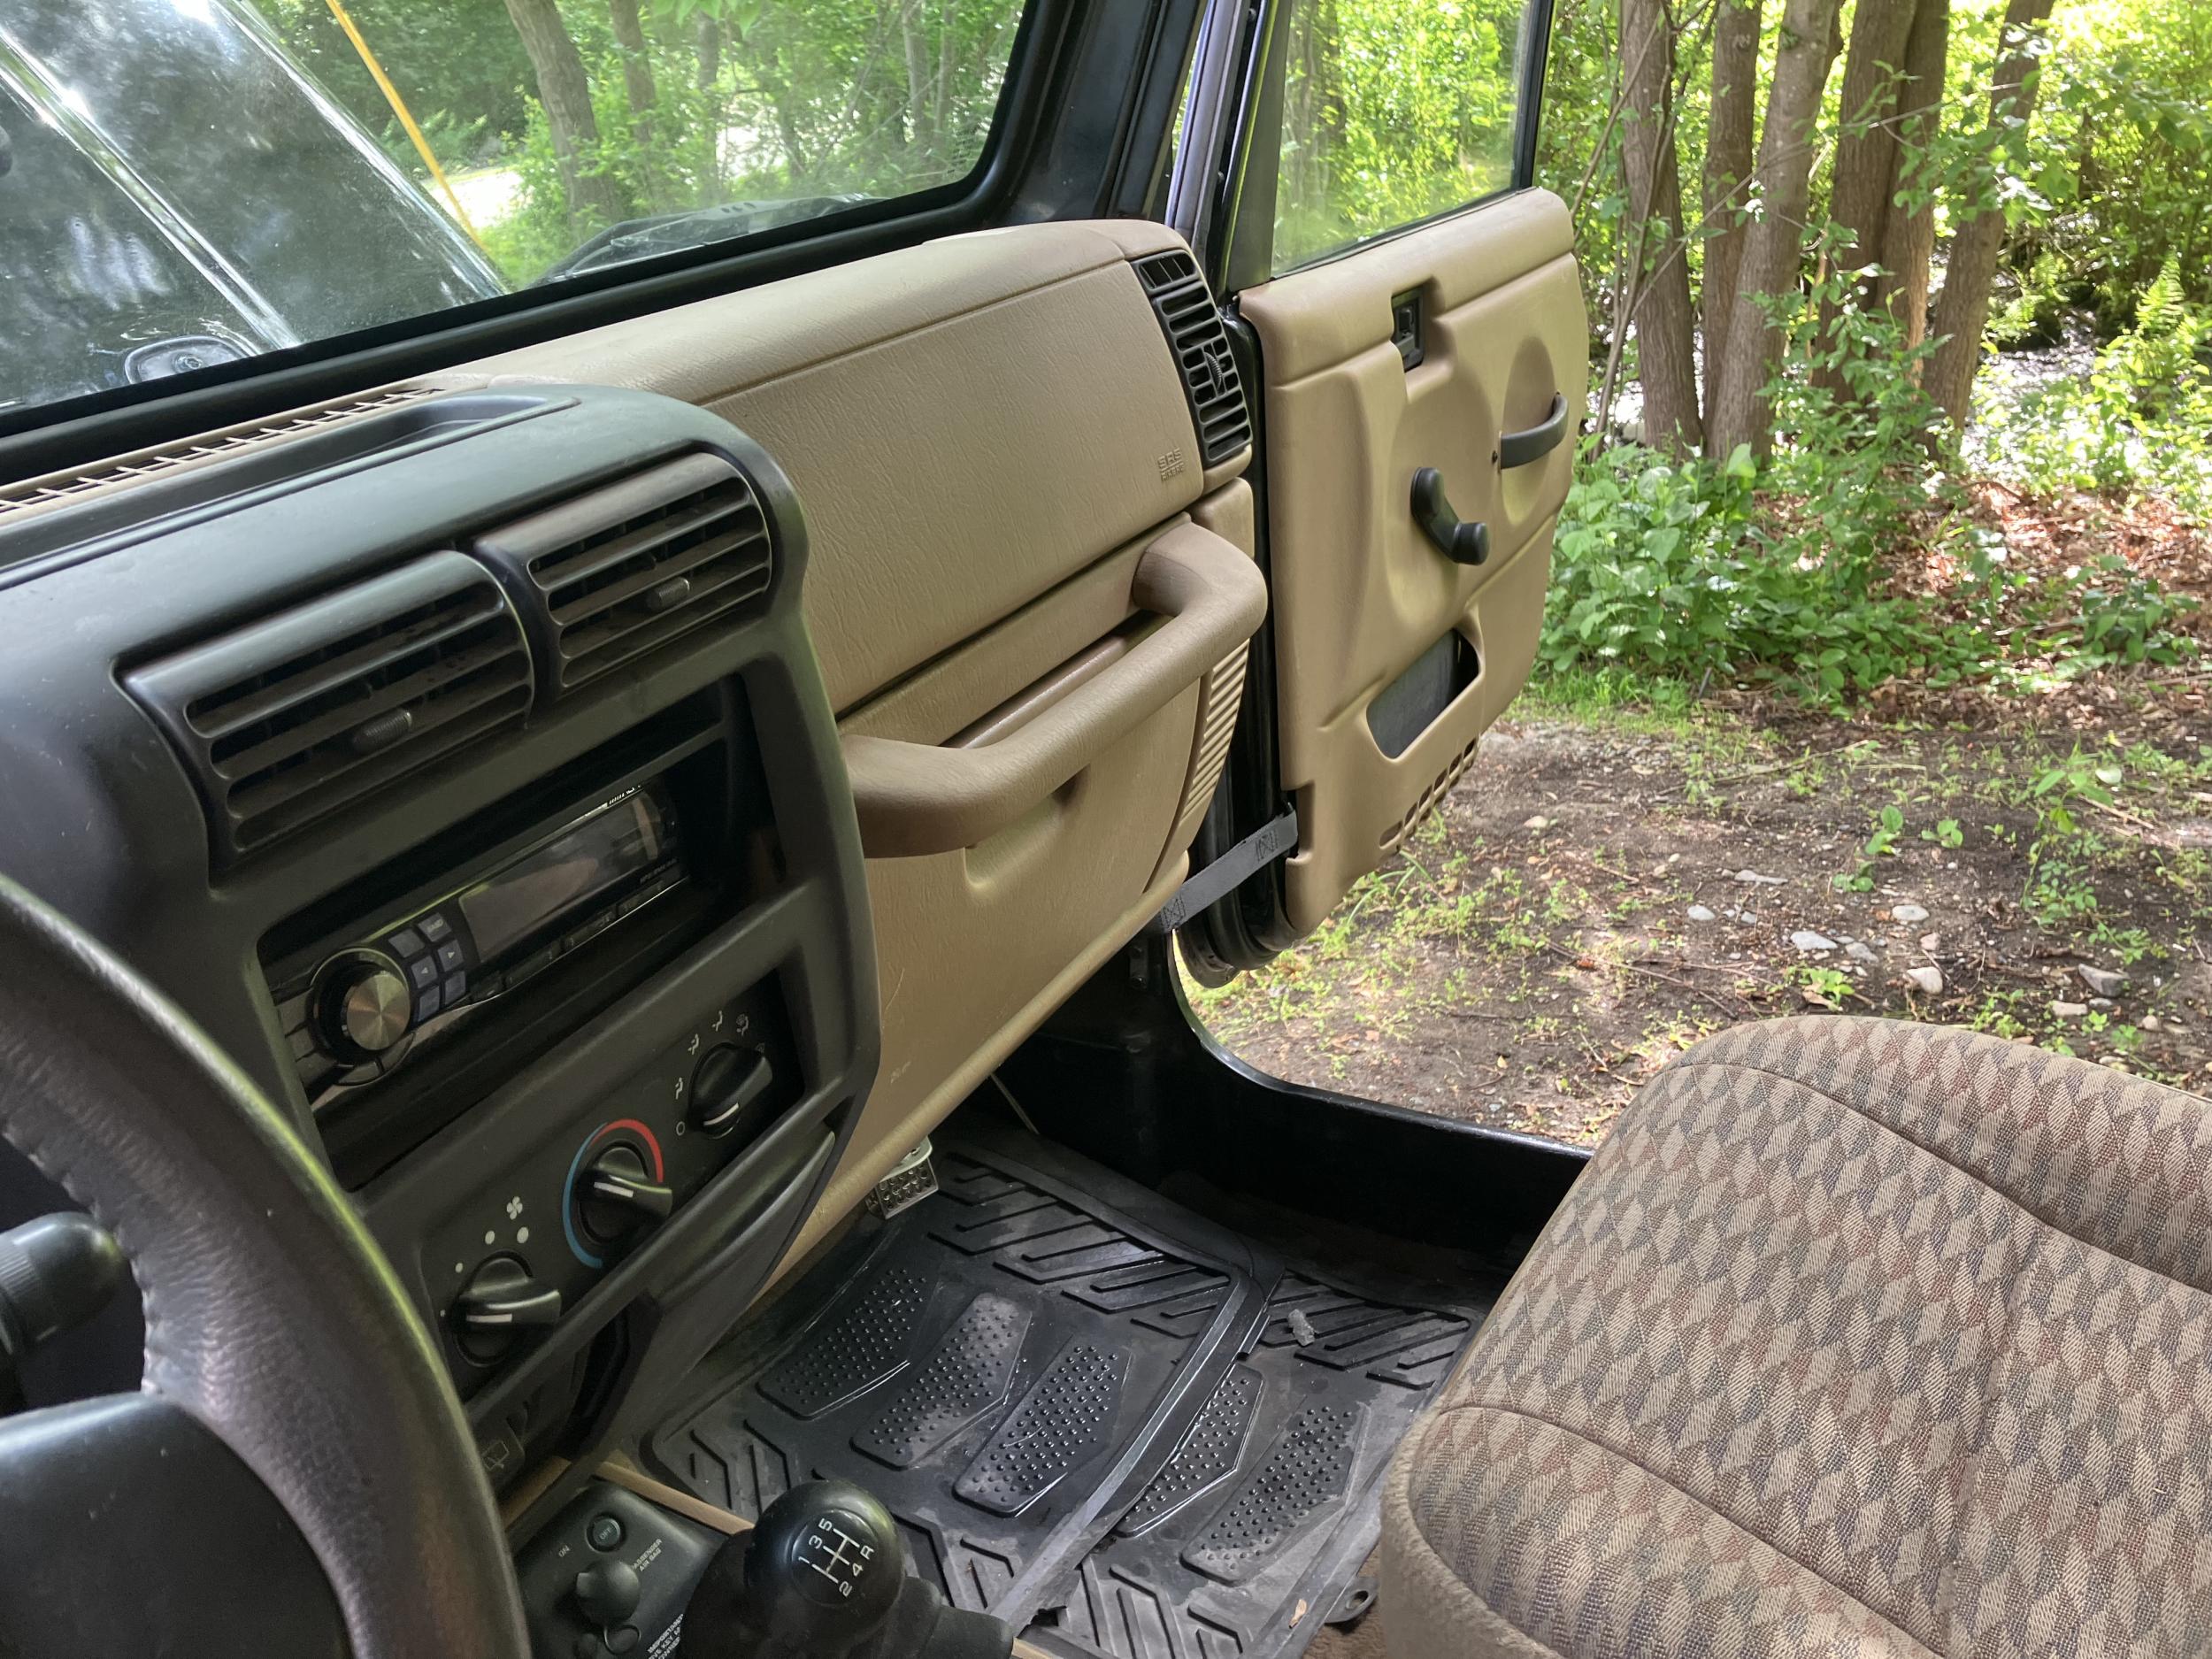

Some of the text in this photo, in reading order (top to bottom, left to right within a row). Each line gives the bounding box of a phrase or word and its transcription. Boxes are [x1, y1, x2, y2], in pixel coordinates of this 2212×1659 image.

[1157, 447, 1181, 469] SRS
[809, 1535, 823, 1549] 3
[818, 1517, 833, 1532] 5
[631, 1539, 662, 1570] ASSENGER
[839, 1545, 875, 1597] 2 4 R
